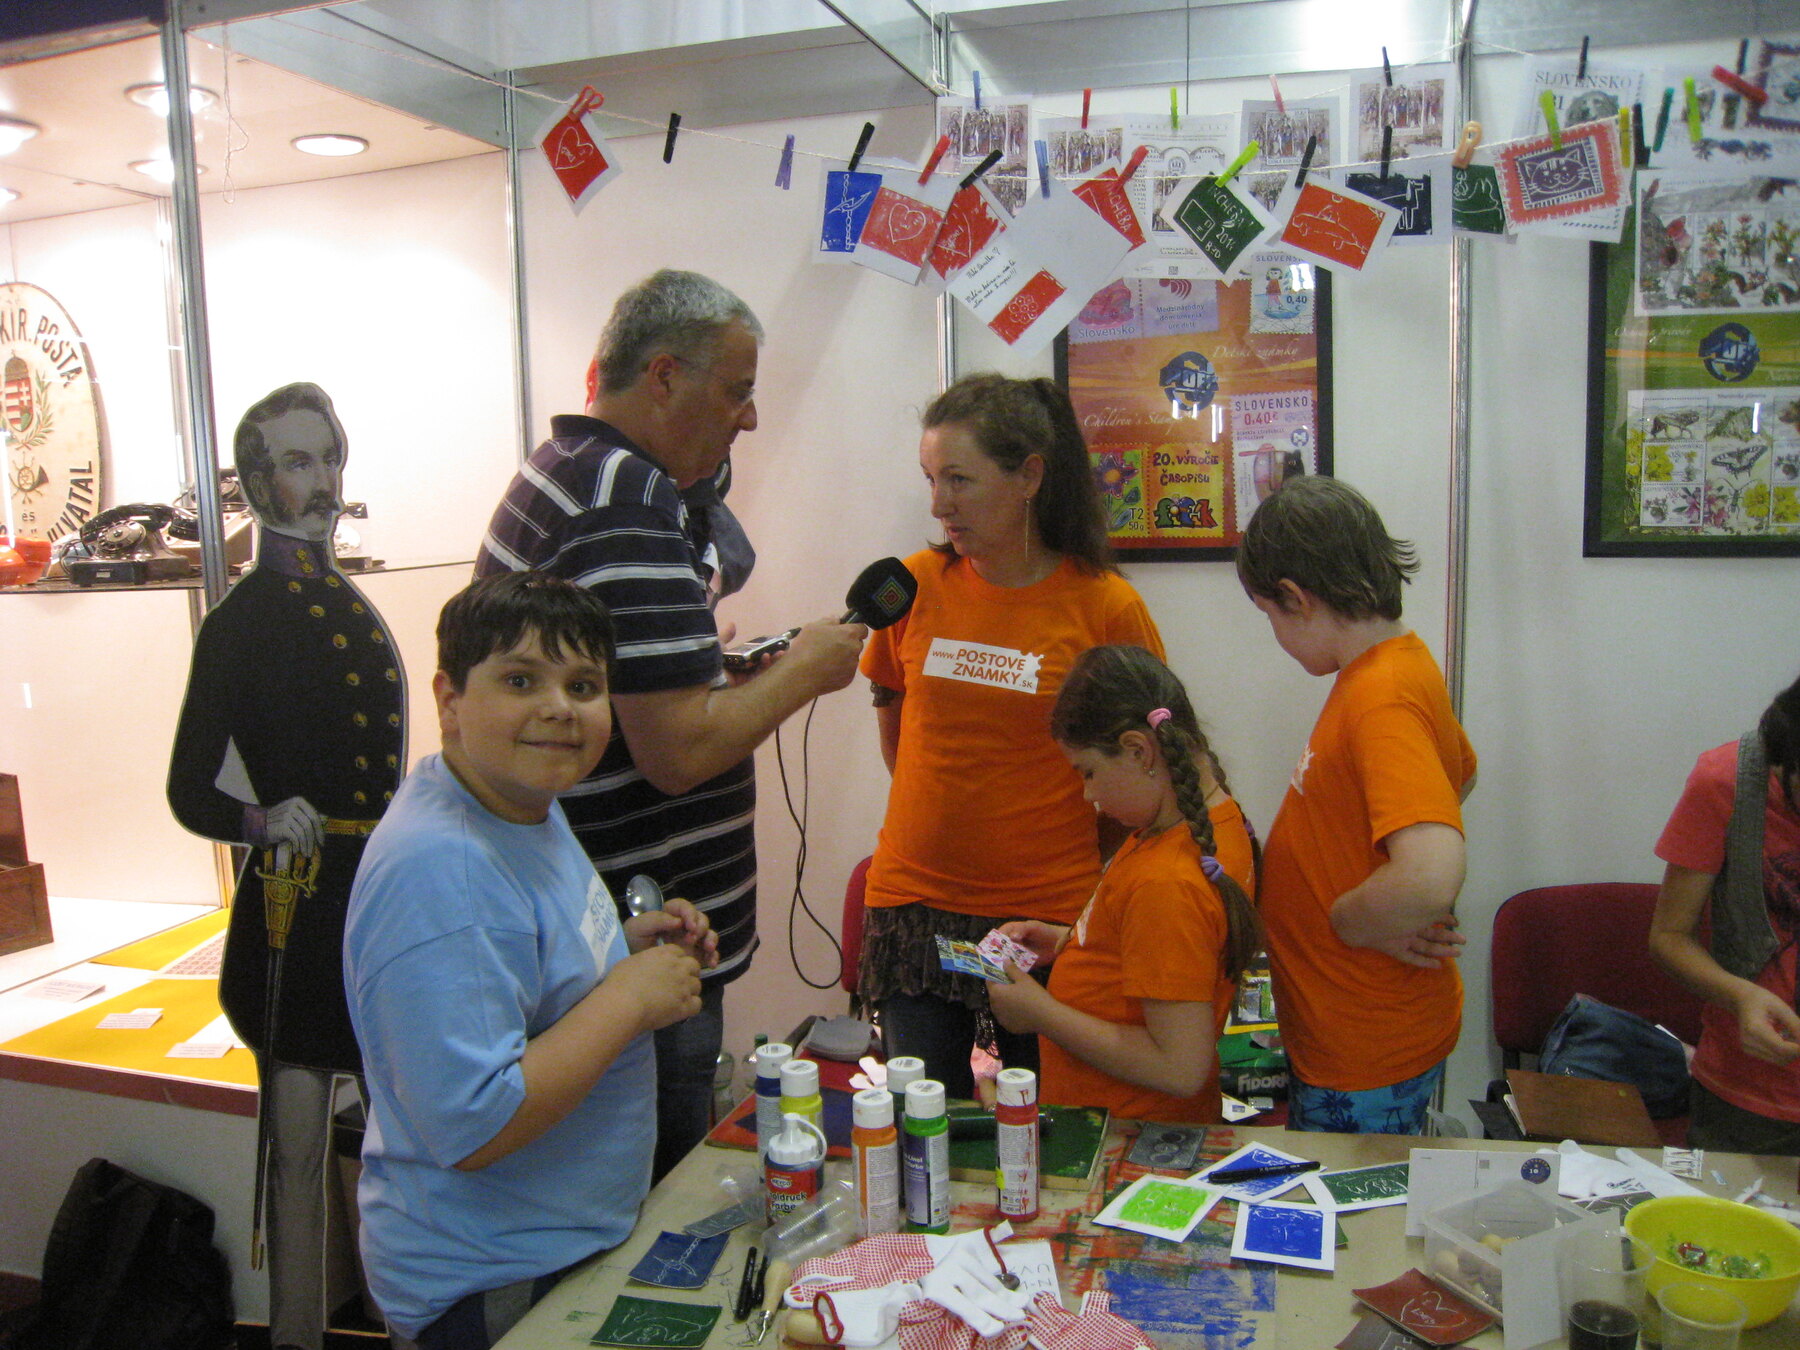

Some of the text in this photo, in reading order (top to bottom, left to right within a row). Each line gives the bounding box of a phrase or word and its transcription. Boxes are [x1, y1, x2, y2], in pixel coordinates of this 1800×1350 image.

[1078, 325, 1136, 338] Slovensko
[1235, 396, 1309, 411] SLOVENSKO
[951, 662, 1022, 685] ZNAMKY
[771, 1201, 796, 1211] Farbe
